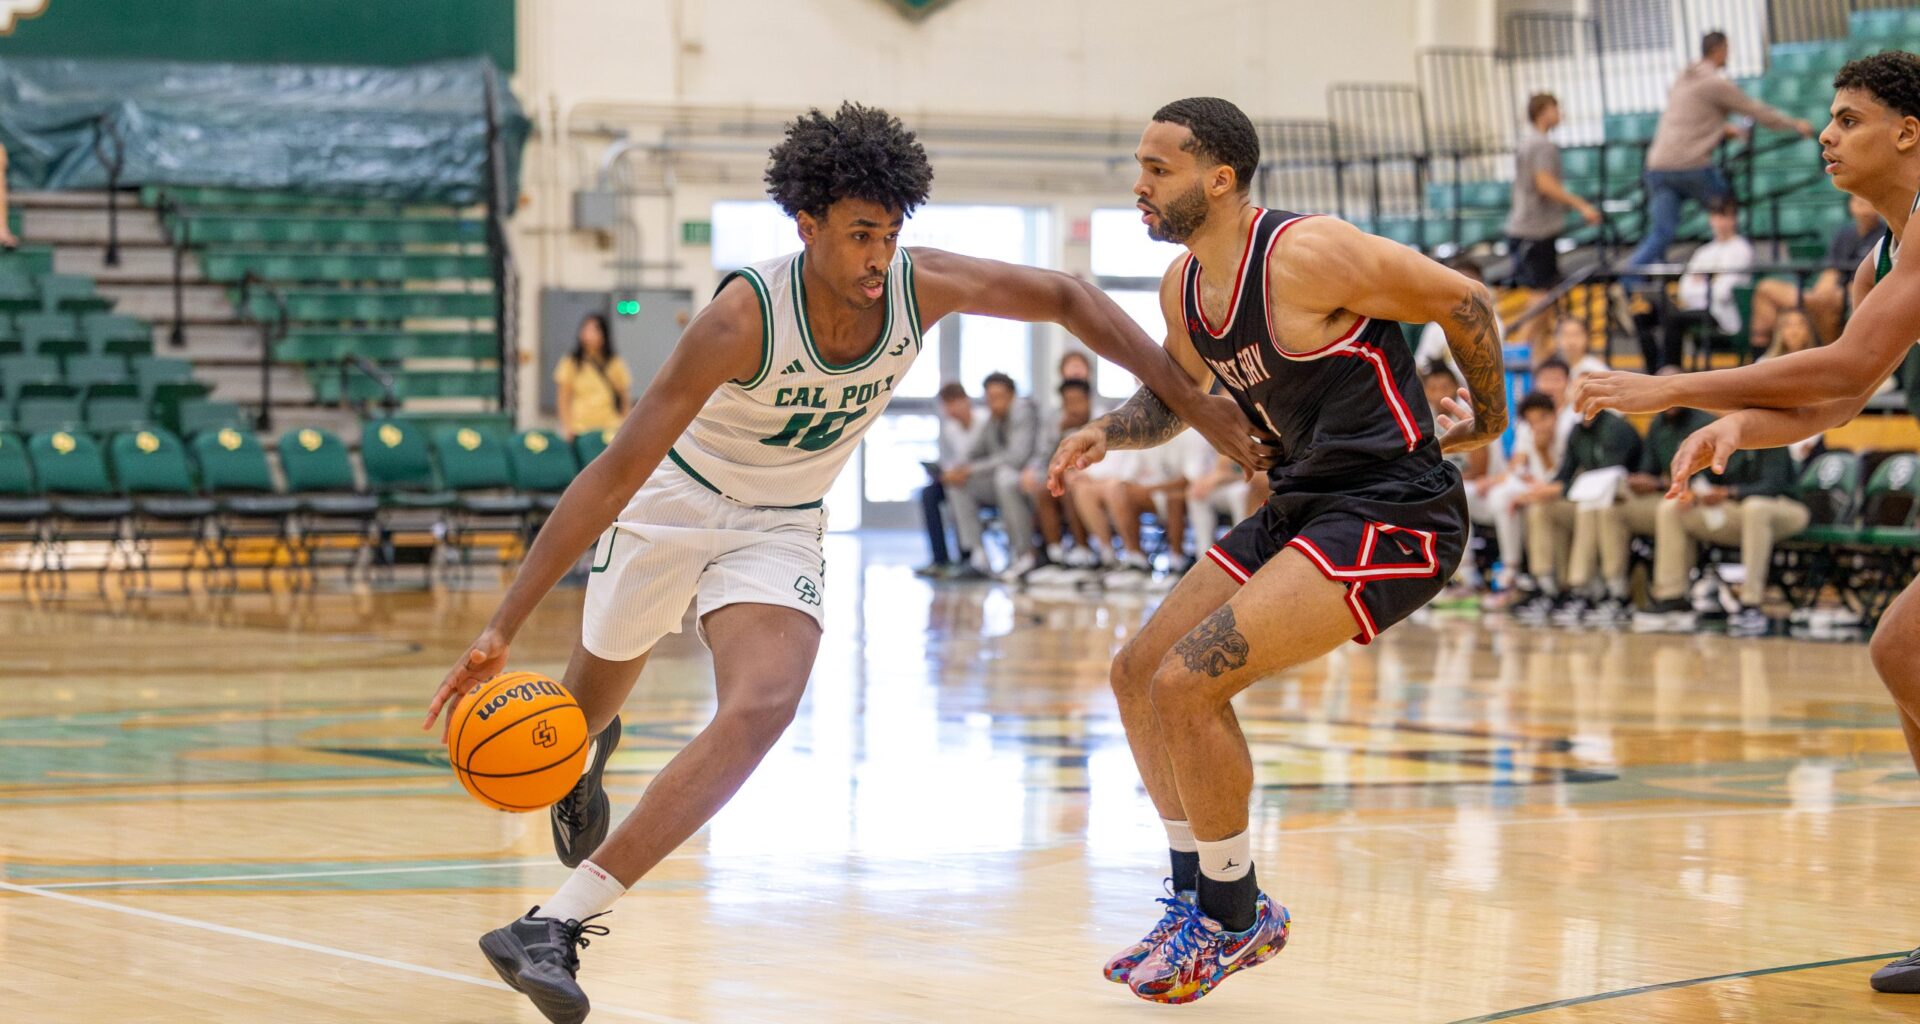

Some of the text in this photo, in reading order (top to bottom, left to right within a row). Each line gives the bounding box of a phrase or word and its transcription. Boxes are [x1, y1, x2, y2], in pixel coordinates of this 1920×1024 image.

[1236, 342, 1271, 386] BAY
[774, 374, 895, 409] CAL POLY
[476, 680, 566, 720] Wilson
